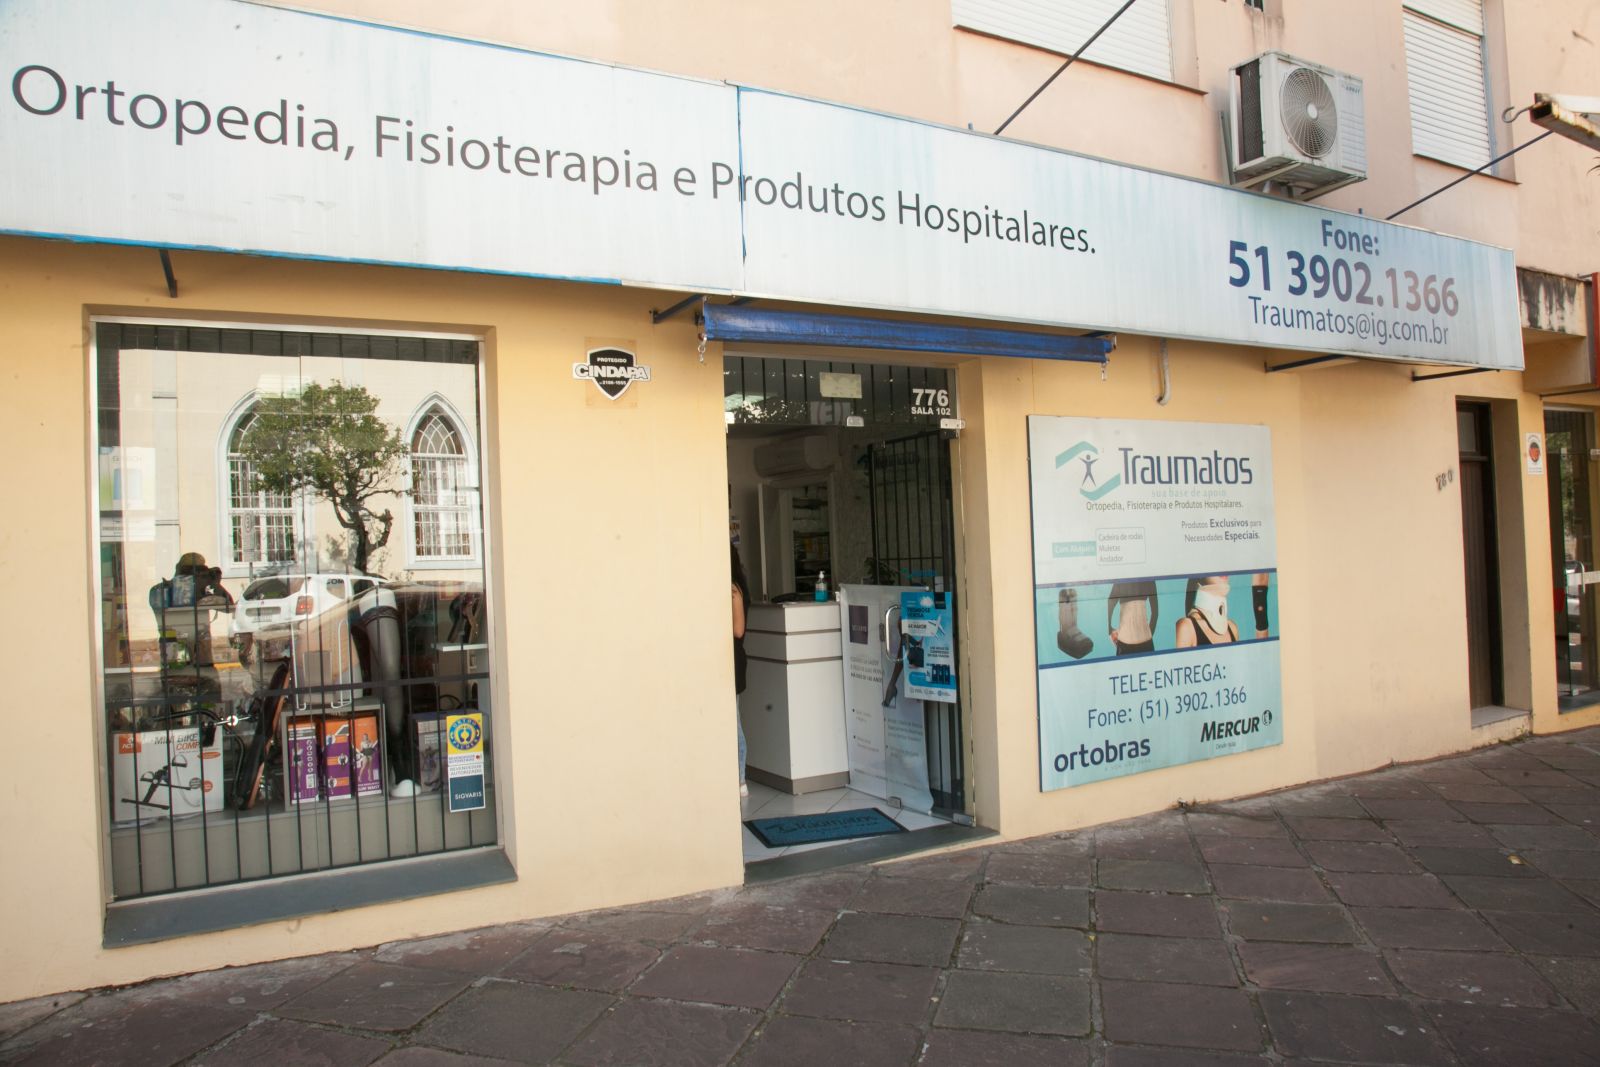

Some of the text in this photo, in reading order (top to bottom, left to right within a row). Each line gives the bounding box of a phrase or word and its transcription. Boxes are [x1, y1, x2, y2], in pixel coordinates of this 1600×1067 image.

[12, 65, 1096, 254] Ortopedia, Fisioterapia e Produtos Hospitalares.
[1321, 219, 1380, 256] Fone:
[1229, 240, 1459, 317] 51 3902.1366
[1248, 296, 1449, 345] Traumatos@ig.com.br
[575, 364, 649, 379] CINDAPA
[911, 406, 951, 416] SALA 102
[912, 388, 949, 407] 776
[1118, 447, 1253, 485] Traumatos
[1086, 501, 1125, 511] Ortopedia,
[1127, 500, 1167, 511] Fisioterapia
[1174, 500, 1203, 510] Produtos
[1181, 520, 1209, 529] Produtos
[1209, 518, 1249, 528] Exclusivos
[1109, 664, 1226, 695] TELE-ENTREGA:
[1088, 686, 1247, 729] Fone: (51) 3902.1366
[1053, 738, 1151, 772] ortobras
